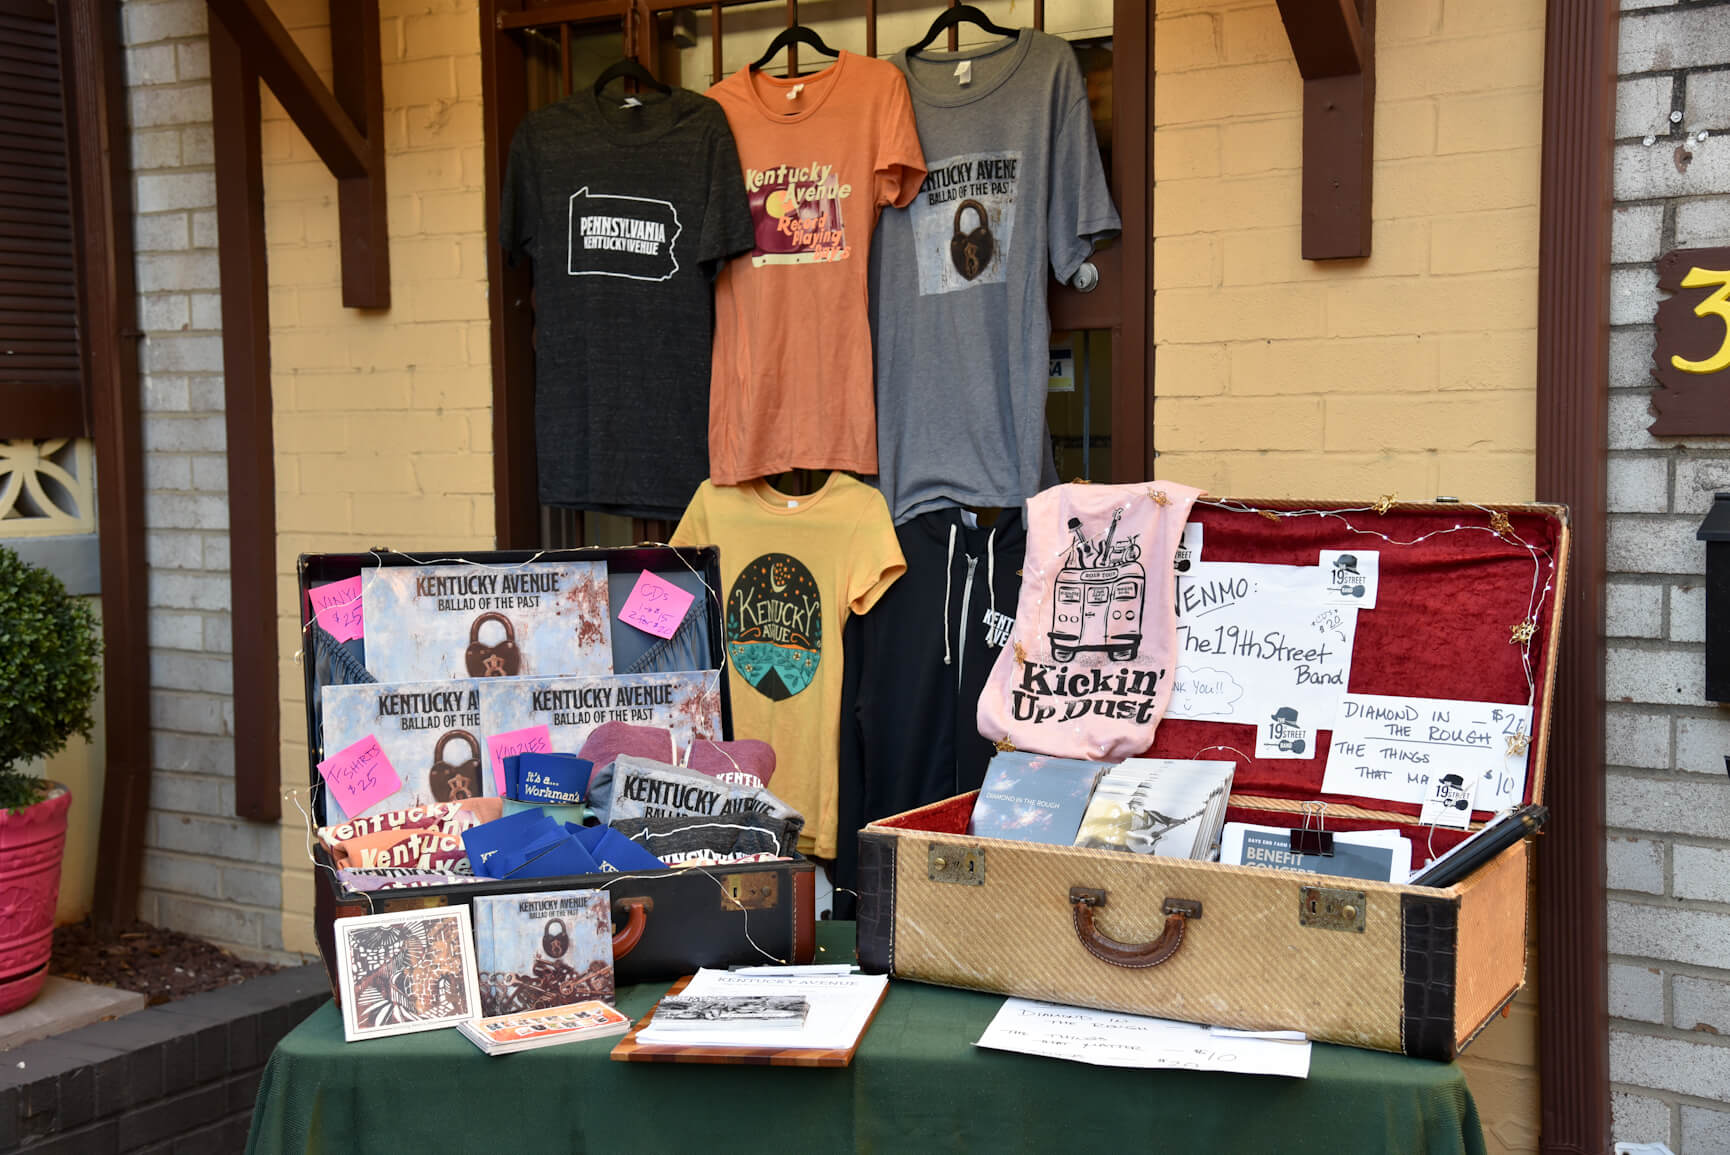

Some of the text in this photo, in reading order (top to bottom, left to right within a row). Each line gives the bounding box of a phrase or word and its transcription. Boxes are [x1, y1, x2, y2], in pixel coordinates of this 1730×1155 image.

[745, 161, 832, 193] Kentucky
[784, 184, 852, 208] Avenue
[970, 183, 987, 196] THE
[777, 213, 828, 236] Record
[1671, 267, 1730, 373] 3
[416, 572, 560, 597] KENTUCKY AVENUE
[1331, 569, 1345, 584] 19
[438, 595, 540, 611] BALLAD OF THE PAST
[1019, 660, 1166, 698] Kickin'
[1294, 664, 1344, 685] Band
[378, 691, 463, 716] KENTUCKY
[532, 684, 673, 711] KENTUCKY AVENUE
[1012, 690, 1155, 724] Up Dust
[401, 713, 480, 731] BALLAD OF THE
[554, 708, 654, 726] BALLAD OF THE PAST
[1343, 701, 1419, 722] DIAMOND
[1432, 711, 1451, 723] IN
[1270, 723, 1283, 740] 19
[1384, 724, 1492, 745] THE ROUGH
[1335, 741, 1430, 764] THE THINGS
[1355, 766, 1393, 780] THAT
[624, 775, 722, 816] KENTUCKY
[1436, 785, 1449, 798] 19
[318, 802, 463, 848] Kentucky
[1246, 846, 1304, 866] BENEFIT
[519, 897, 588, 912] KENTUCKY AVENUE
